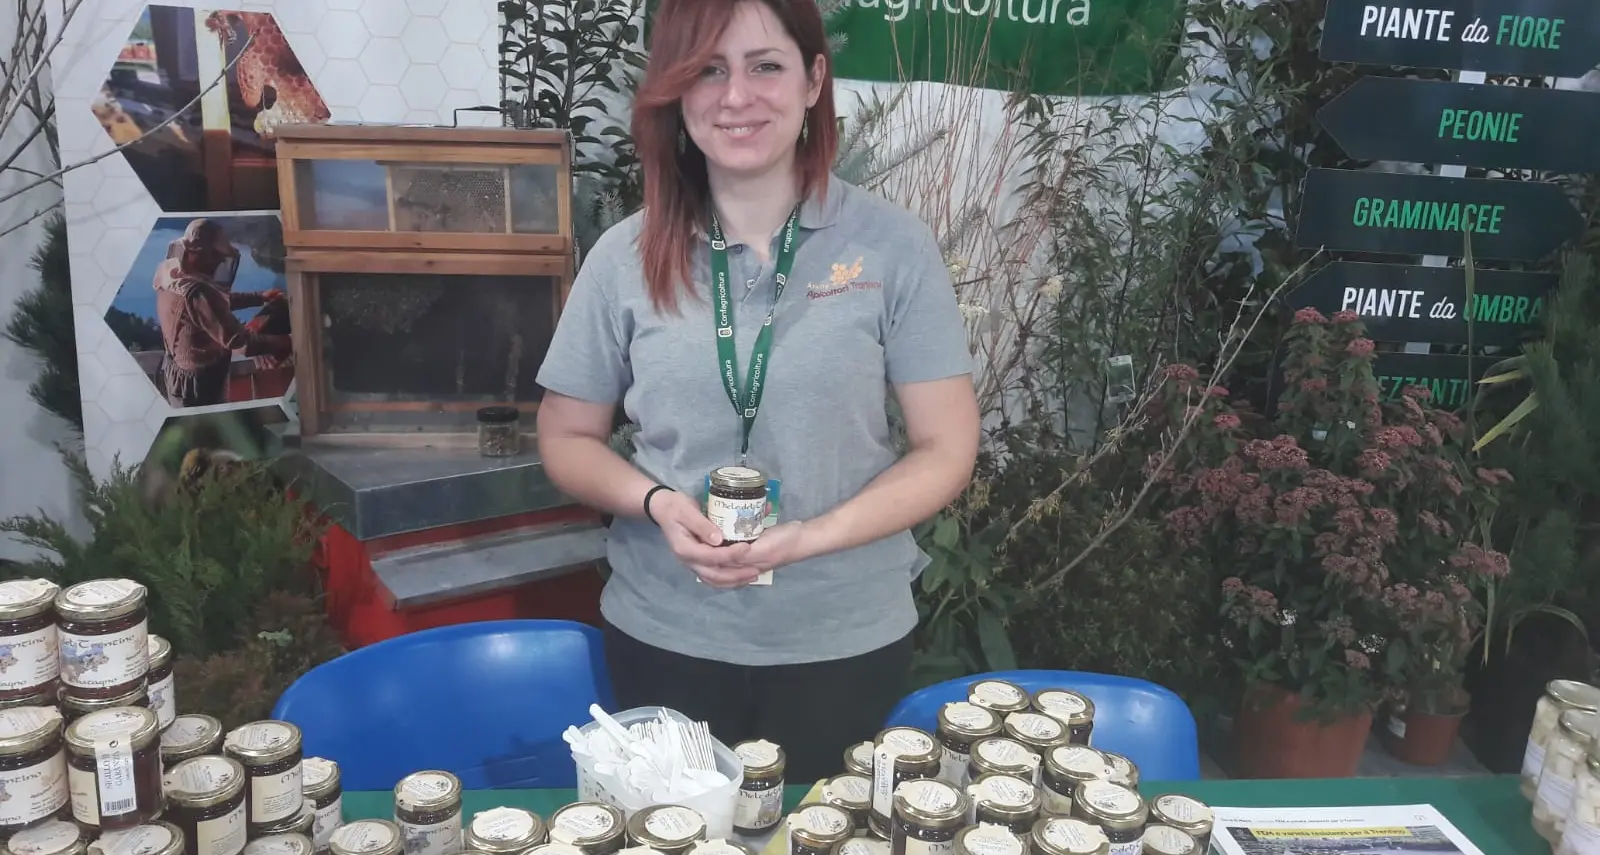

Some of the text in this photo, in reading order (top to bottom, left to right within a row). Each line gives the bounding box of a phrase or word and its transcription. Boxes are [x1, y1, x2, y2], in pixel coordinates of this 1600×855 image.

[1360, 5, 1565, 50] PIANTE da FIORE
[1438, 108, 1524, 143] PEONIE
[1352, 197, 1505, 234] GRAMINACEE
[718, 271, 728, 326] Confagricoltura
[1341, 286, 1543, 324] PIANTE da OMBRA
[748, 353, 764, 407] Confagricoltura
